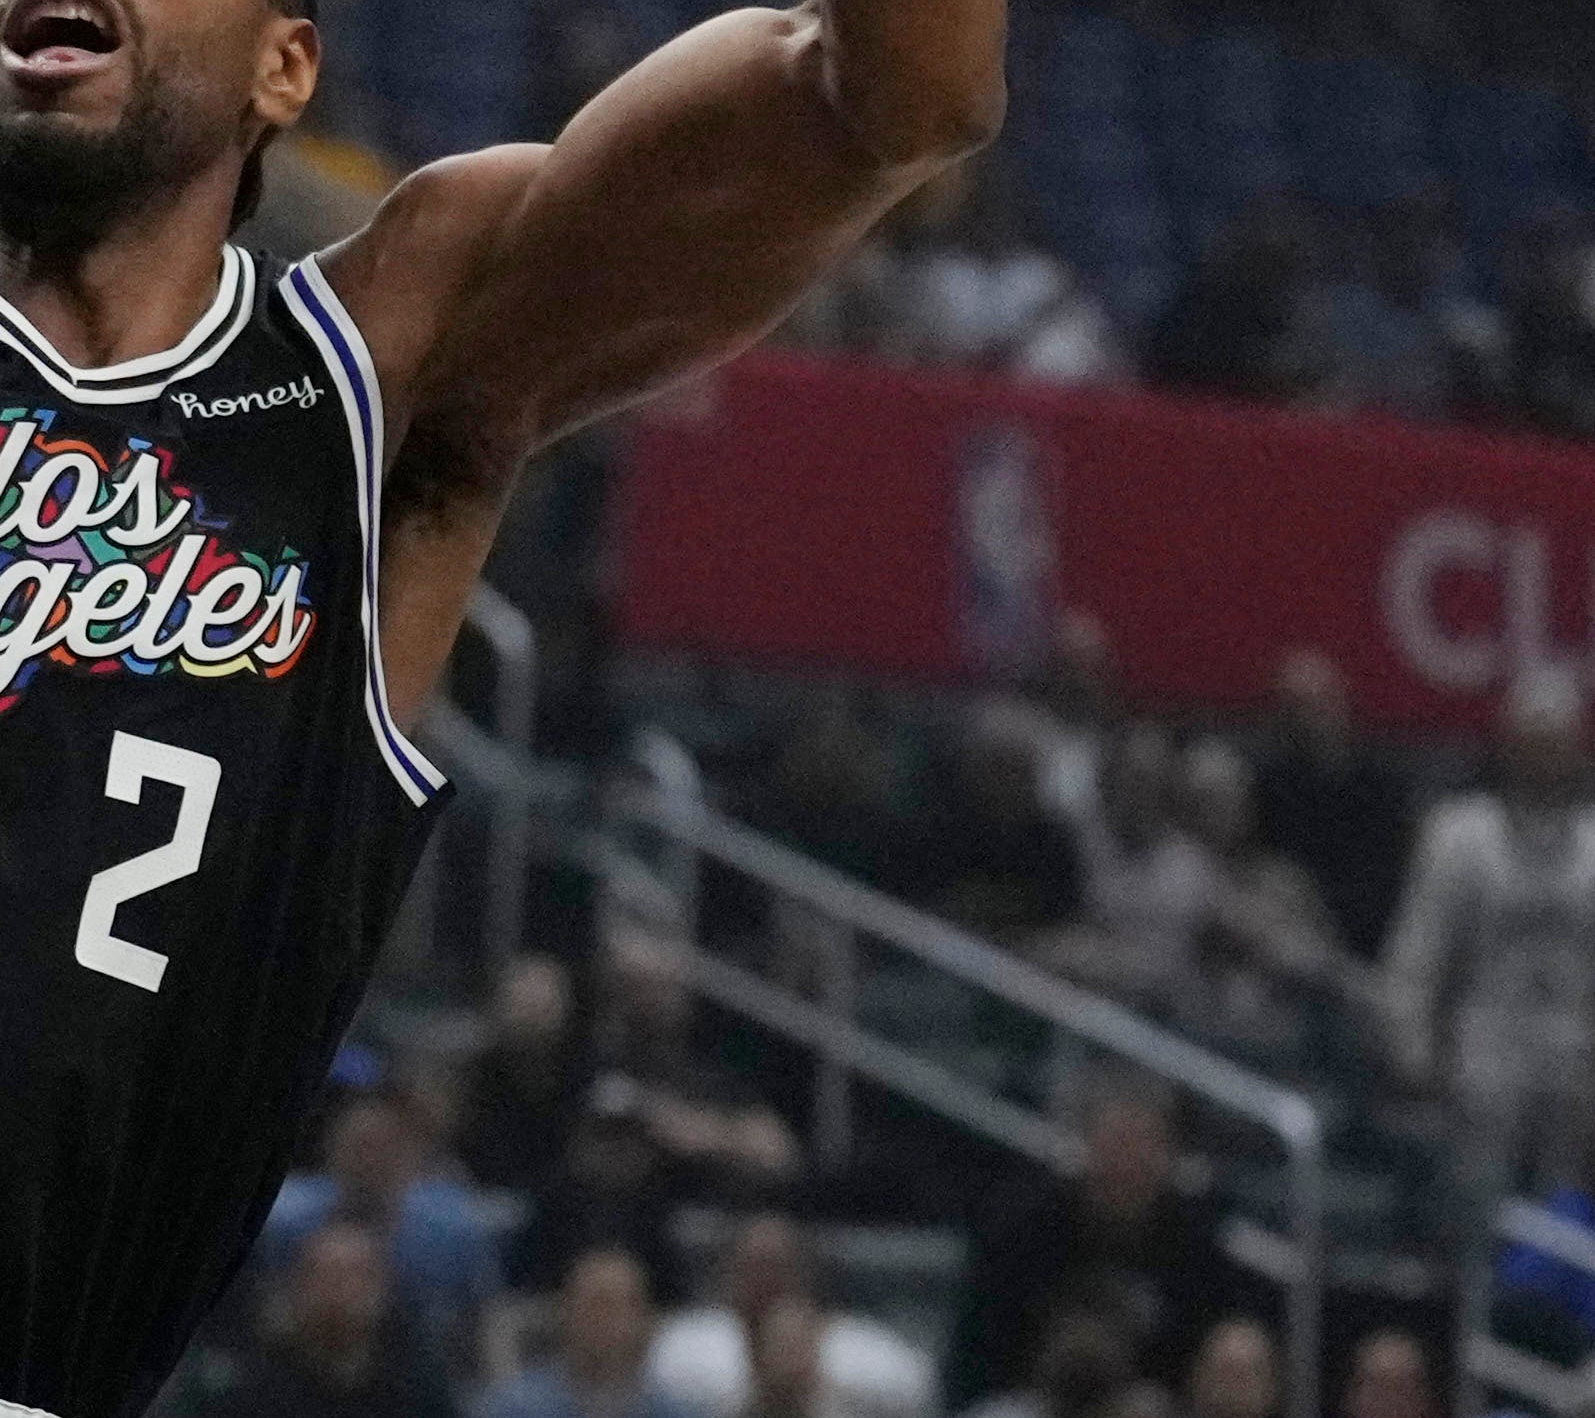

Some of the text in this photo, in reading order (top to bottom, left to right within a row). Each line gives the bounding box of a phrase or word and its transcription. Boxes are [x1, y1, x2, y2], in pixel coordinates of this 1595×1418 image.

[170, 376, 324, 419] honey
[1381, 503, 1595, 695] CL
[74, 730, 222, 993] 2
